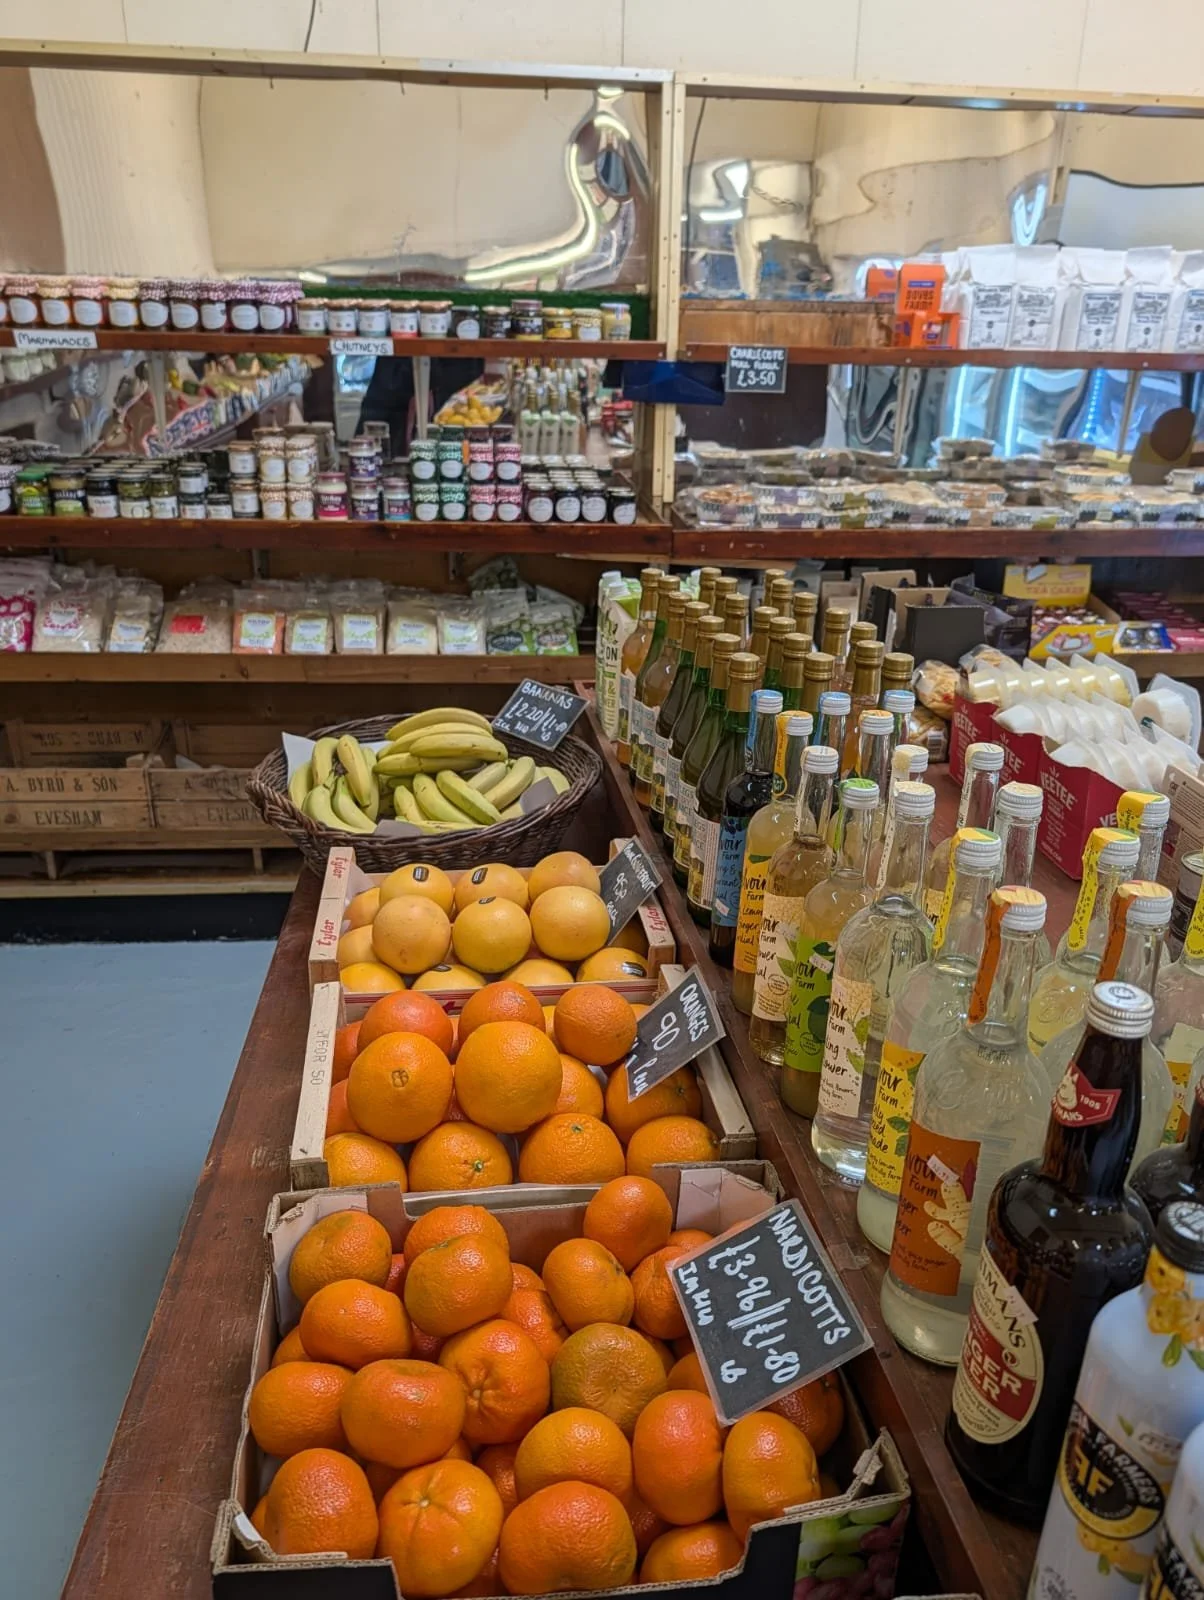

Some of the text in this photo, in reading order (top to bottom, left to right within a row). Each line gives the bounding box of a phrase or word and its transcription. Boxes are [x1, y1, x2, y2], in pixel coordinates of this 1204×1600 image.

[334, 339, 388, 353] CHUTNEYS
[521, 682, 573, 709] BANANAS
[27, 777, 65, 793] BYRD
[73, 777, 84, 793] &
[92, 776, 118, 793] SON
[1040, 770, 1077, 812] VEETEE
[34, 809, 102, 826] EVESHAM
[316, 919, 337, 946] tyler
[796, 976, 815, 991] Farm
[679, 983, 710, 1042] ORANGES
[652, 1011, 680, 1051] 90
[829, 1016, 846, 1036] Farm
[878, 1086, 899, 1109] Farm
[909, 1175, 938, 1199] Farm
[768, 1208, 851, 1345] NARDICOTTS
